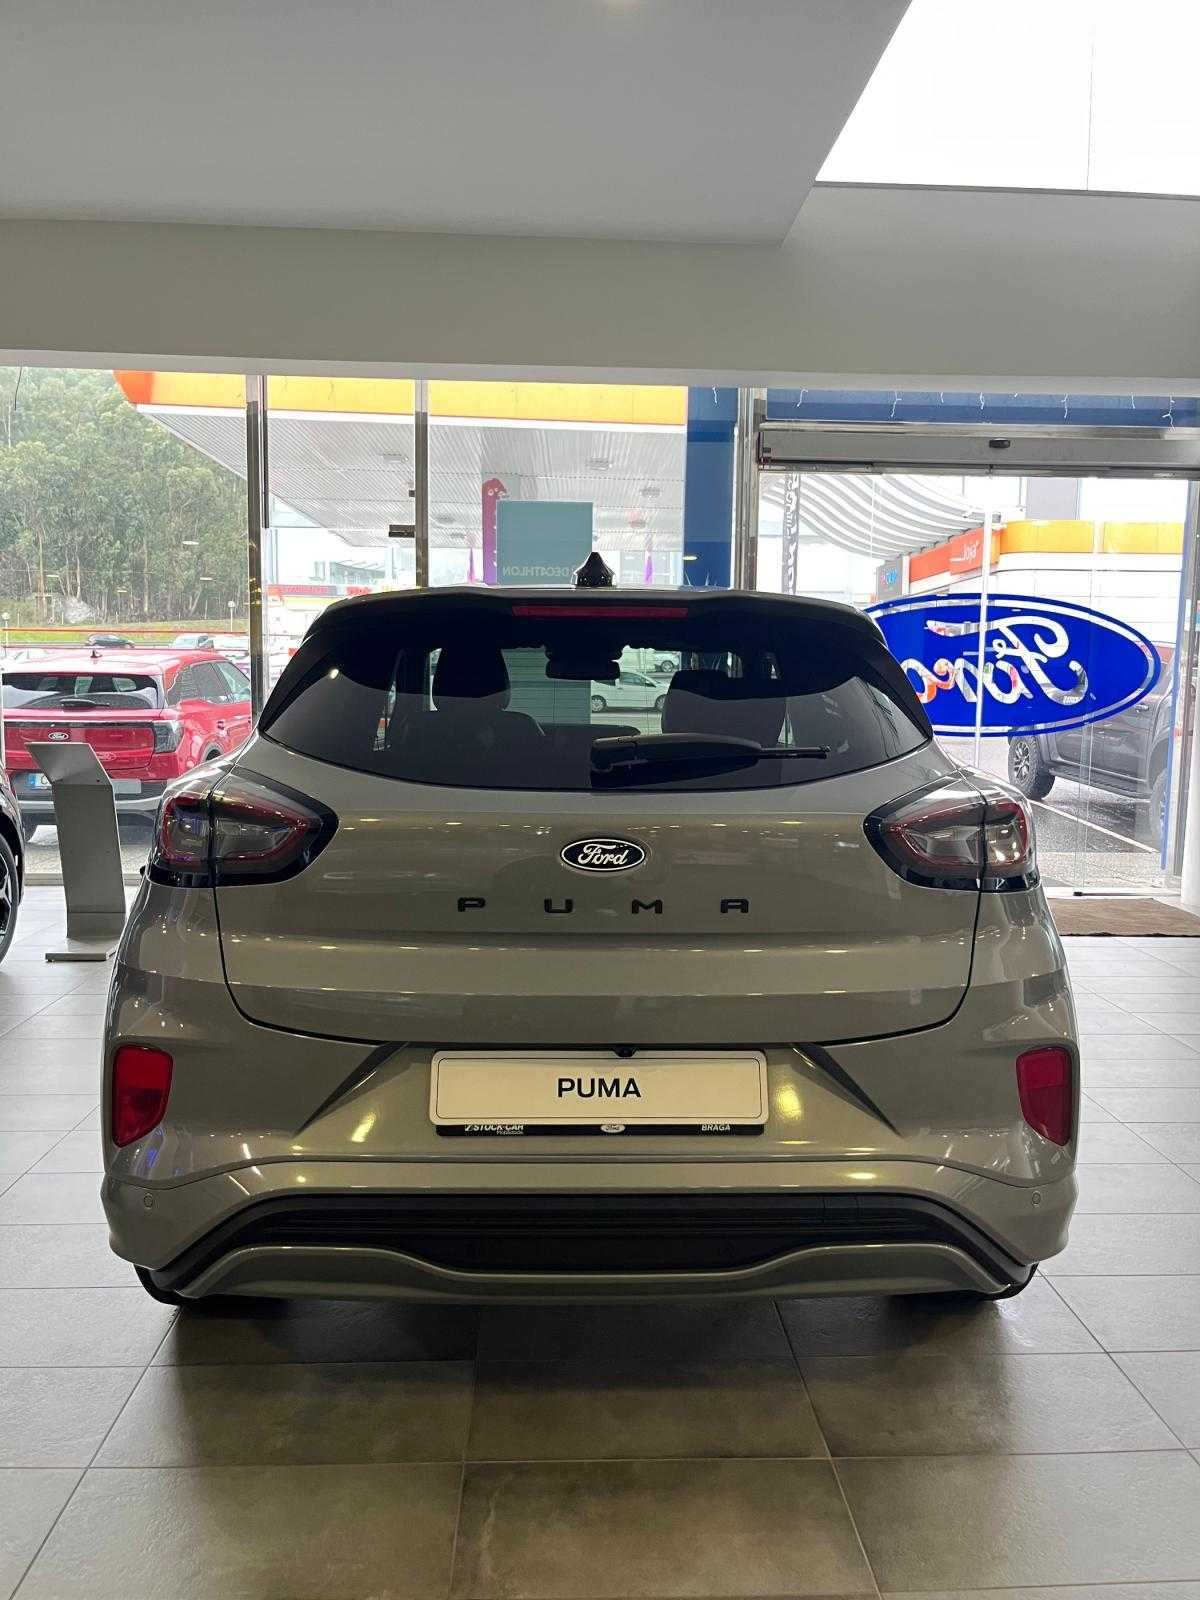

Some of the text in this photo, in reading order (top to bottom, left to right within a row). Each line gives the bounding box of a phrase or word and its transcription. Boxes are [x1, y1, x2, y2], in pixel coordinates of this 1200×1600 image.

[577, 843, 628, 866] Ford
[457, 896, 750, 914] PUMA
[557, 1077, 642, 1099] PUMA
[701, 1123, 731, 1132] BRAGA
